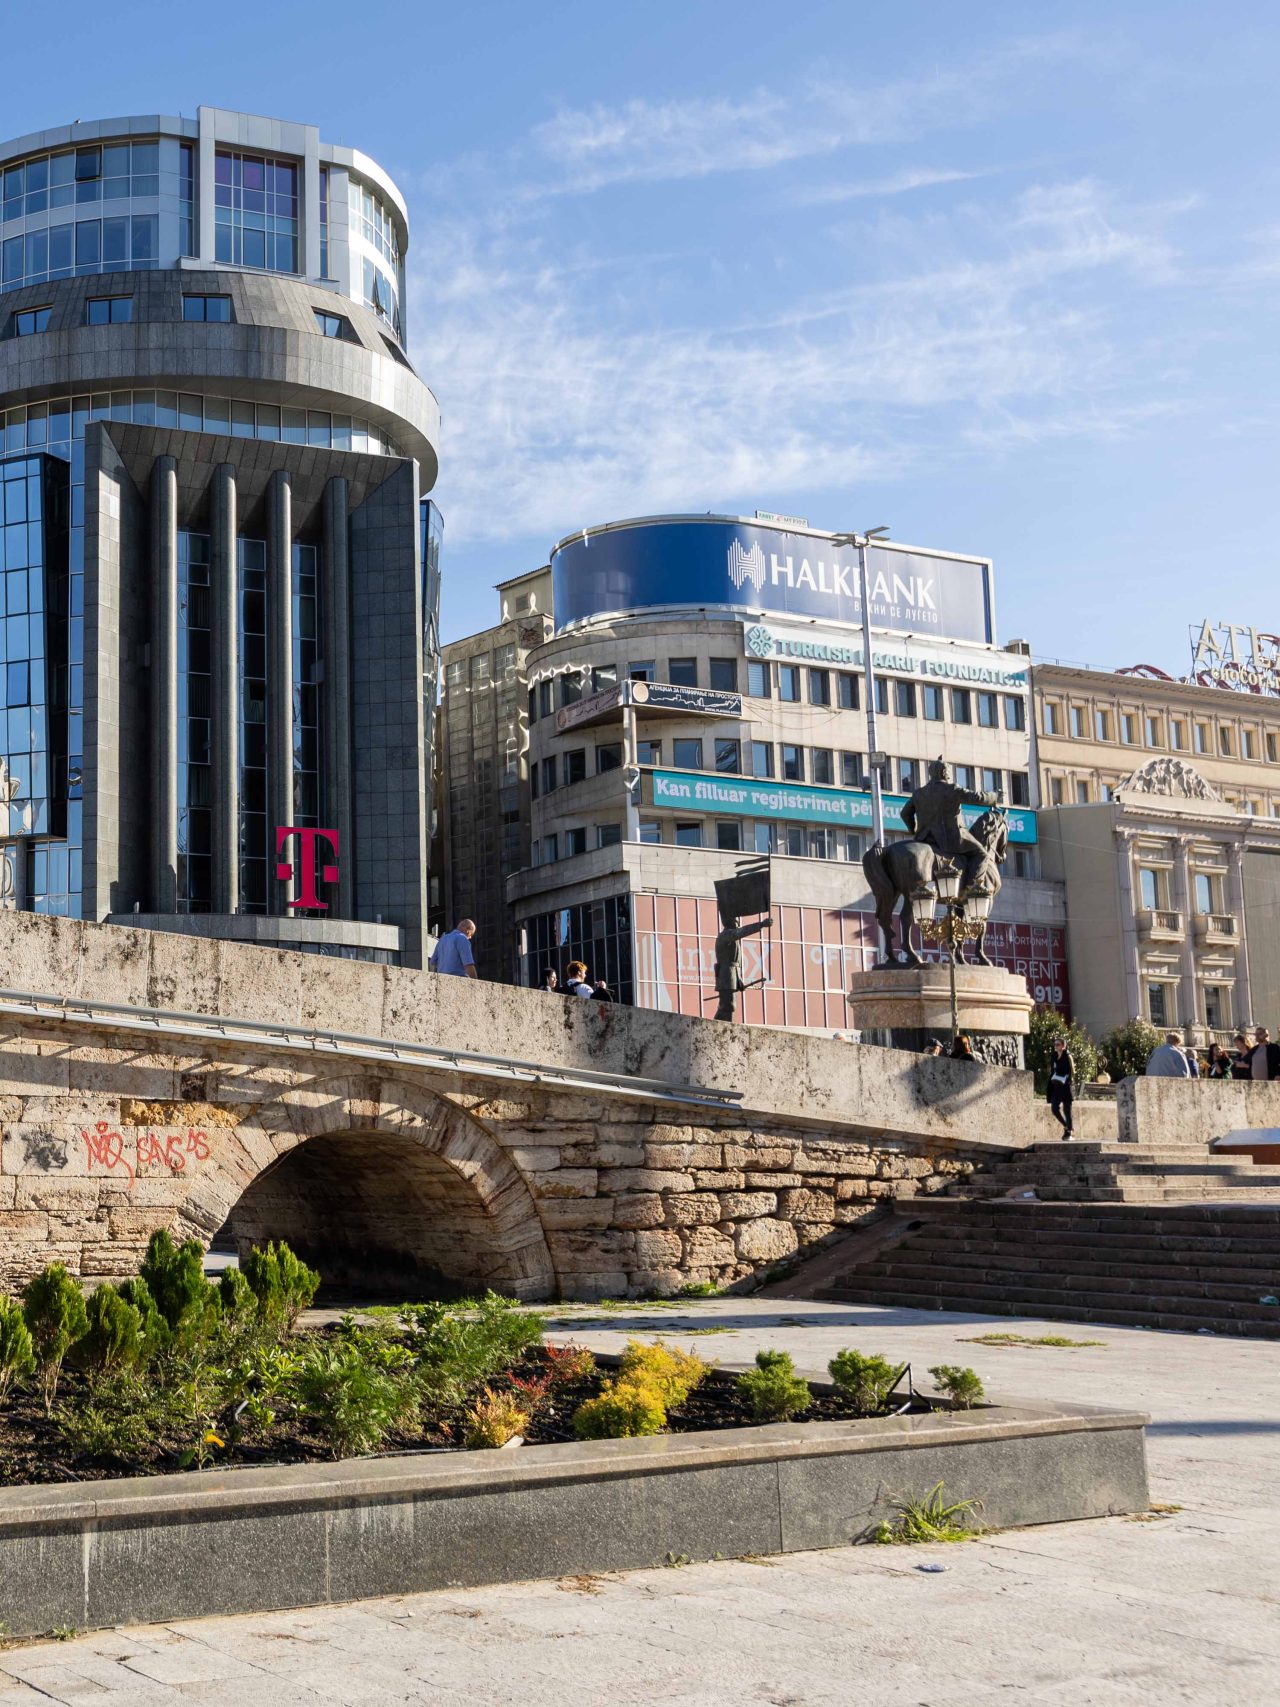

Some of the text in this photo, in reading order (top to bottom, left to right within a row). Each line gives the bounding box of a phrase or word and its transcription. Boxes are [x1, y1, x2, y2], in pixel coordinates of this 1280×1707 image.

[771, 553, 936, 610] HALKBANK
[854, 600, 886, 616] ВНИ
[890, 605, 902, 618] СЕ
[1194, 618, 1280, 671] ATL
[776, 638, 854, 664] TURKISH
[924, 659, 1028, 688] FOUNDATION
[655, 778, 691, 798] Kan
[695, 782, 747, 804] filluar
[751, 790, 847, 814] regjistrimet
[276, 826, 339, 910] T
[809, 946, 888, 969] OFFIC
[1016, 960, 1061, 980] RENT
[1035, 985, 1063, 1004] 919
